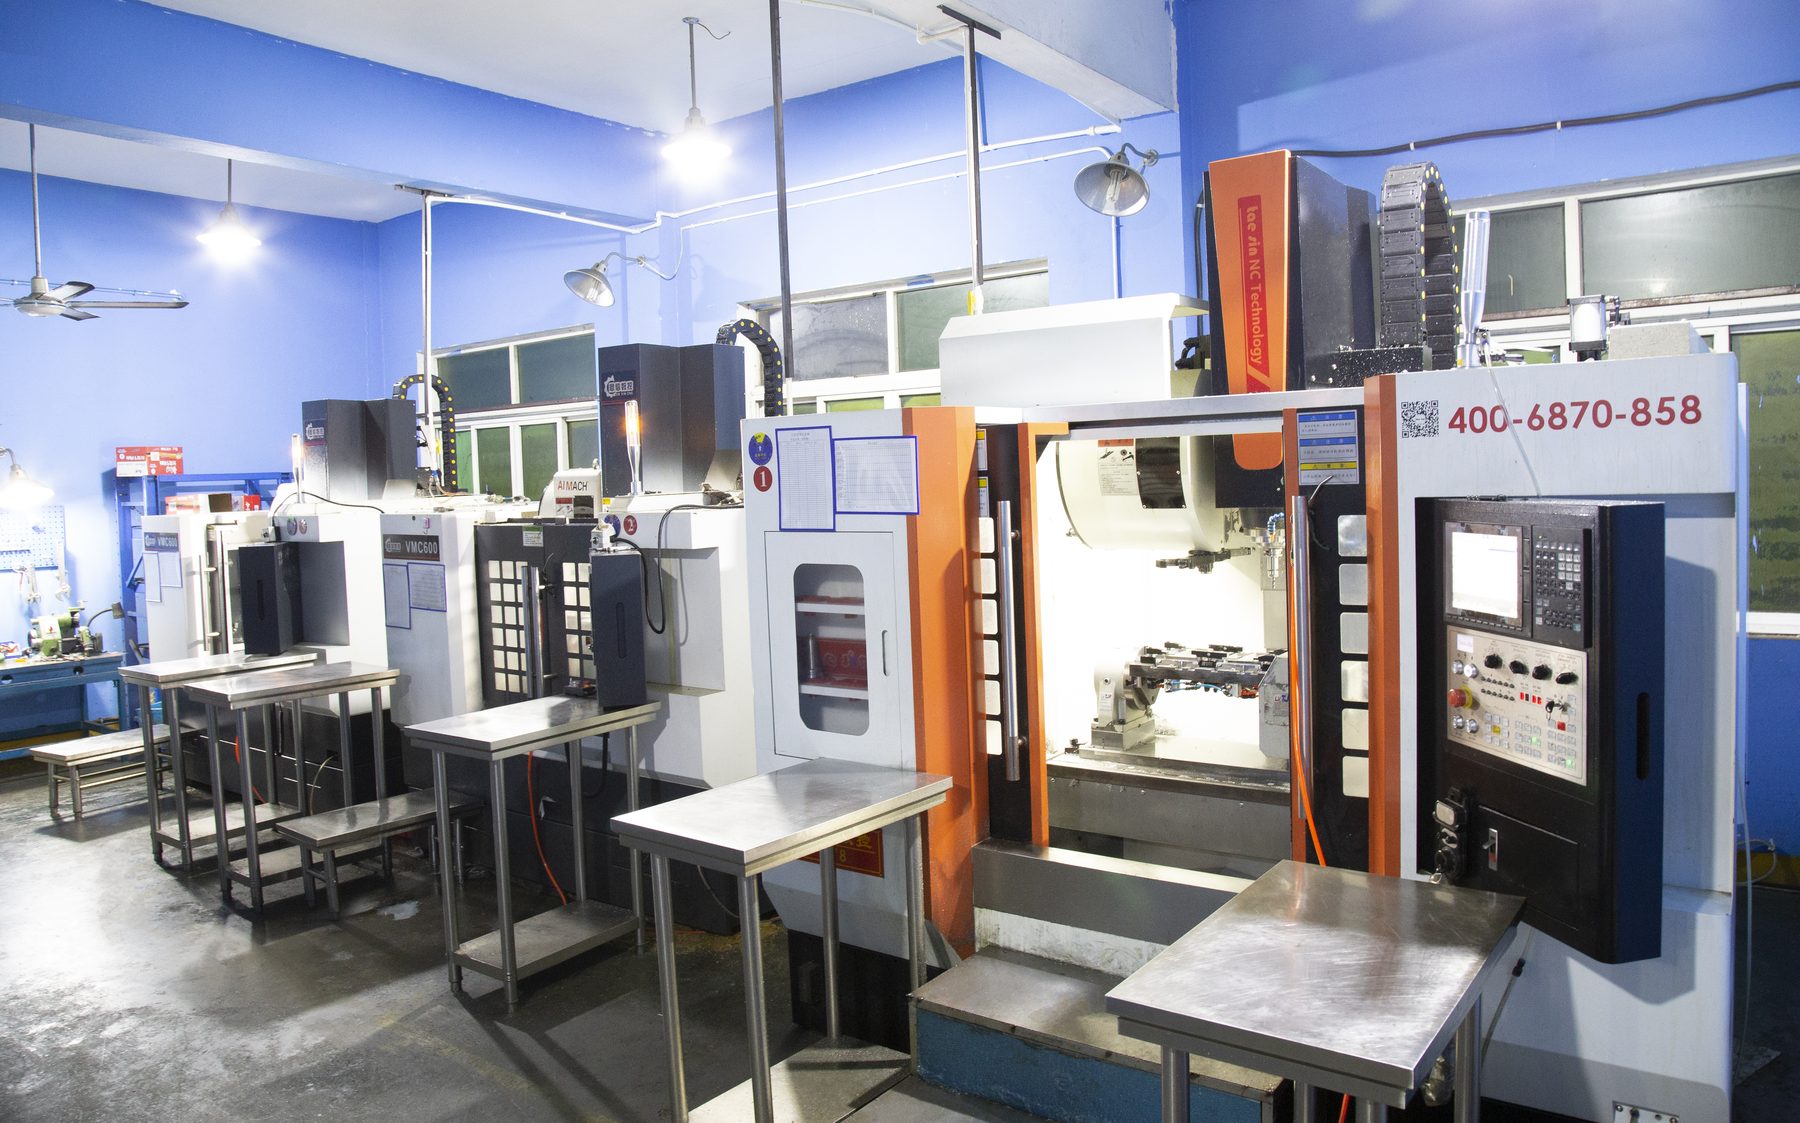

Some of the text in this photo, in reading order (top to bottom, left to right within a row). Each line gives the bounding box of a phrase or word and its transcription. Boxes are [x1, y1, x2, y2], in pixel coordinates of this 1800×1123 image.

[1249, 259, 1261, 280] NC
[1250, 283, 1265, 365] Technology
[1448, 394, 1703, 434] 400-6870-858
[557, 480, 588, 492] AIMACH
[759, 470, 767, 488] 1
[405, 540, 438, 554] VMC600
